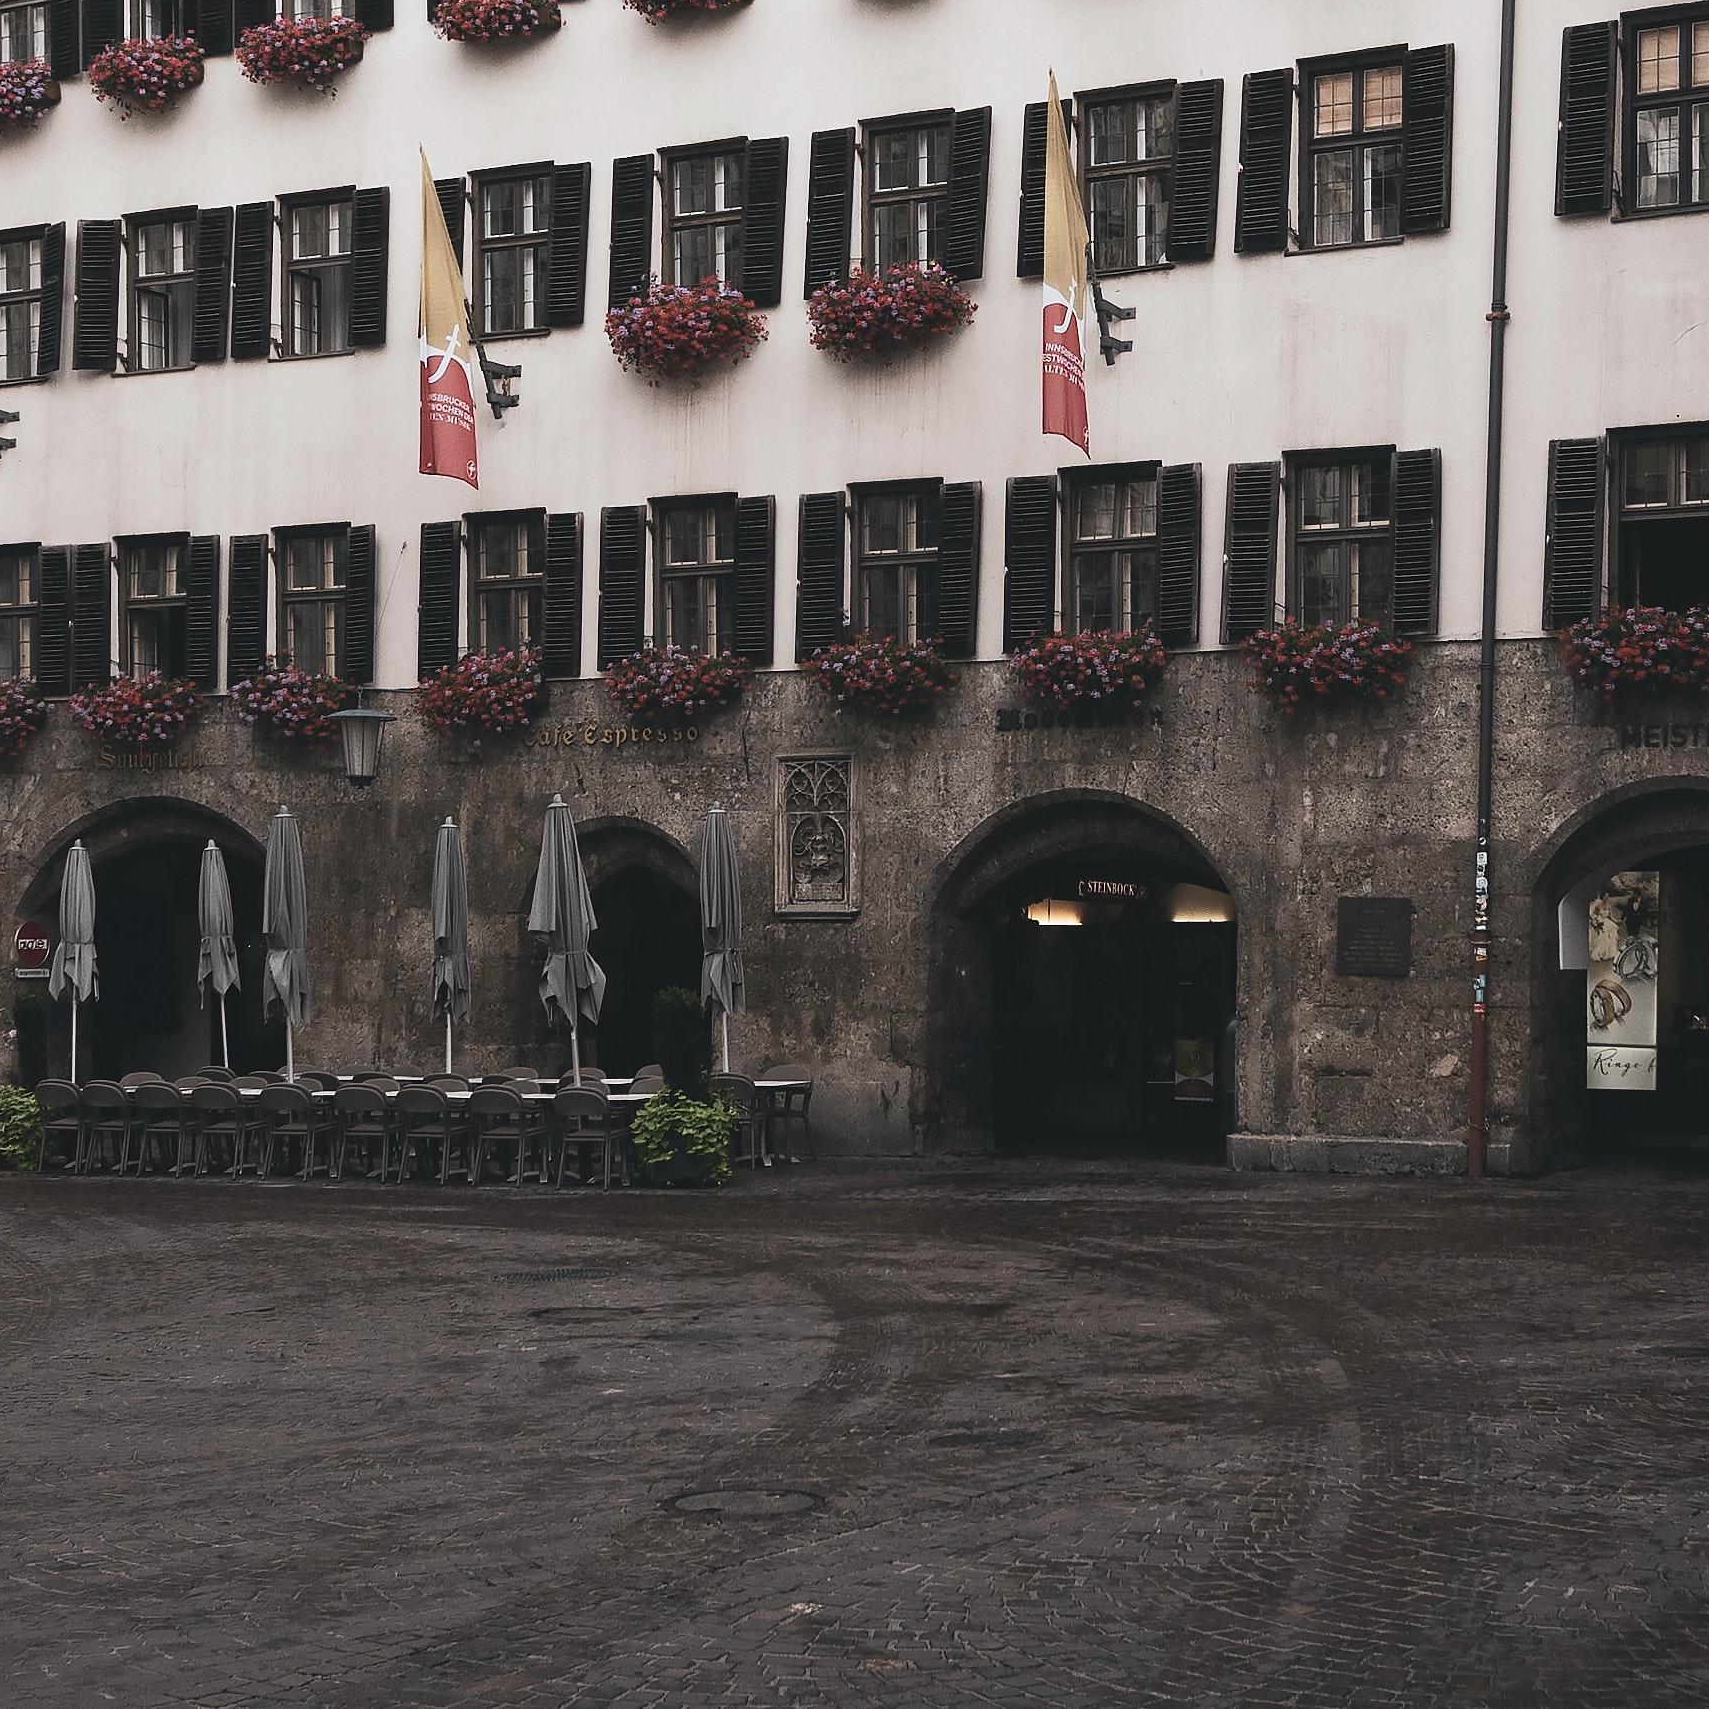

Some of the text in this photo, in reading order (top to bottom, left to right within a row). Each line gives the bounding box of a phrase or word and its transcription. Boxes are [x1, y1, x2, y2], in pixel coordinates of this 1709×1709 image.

[584, 722, 699, 748] Espresso
[1087, 880, 1137, 896] STEINBOCK
[1593, 1048, 1641, 1078] Ringe
